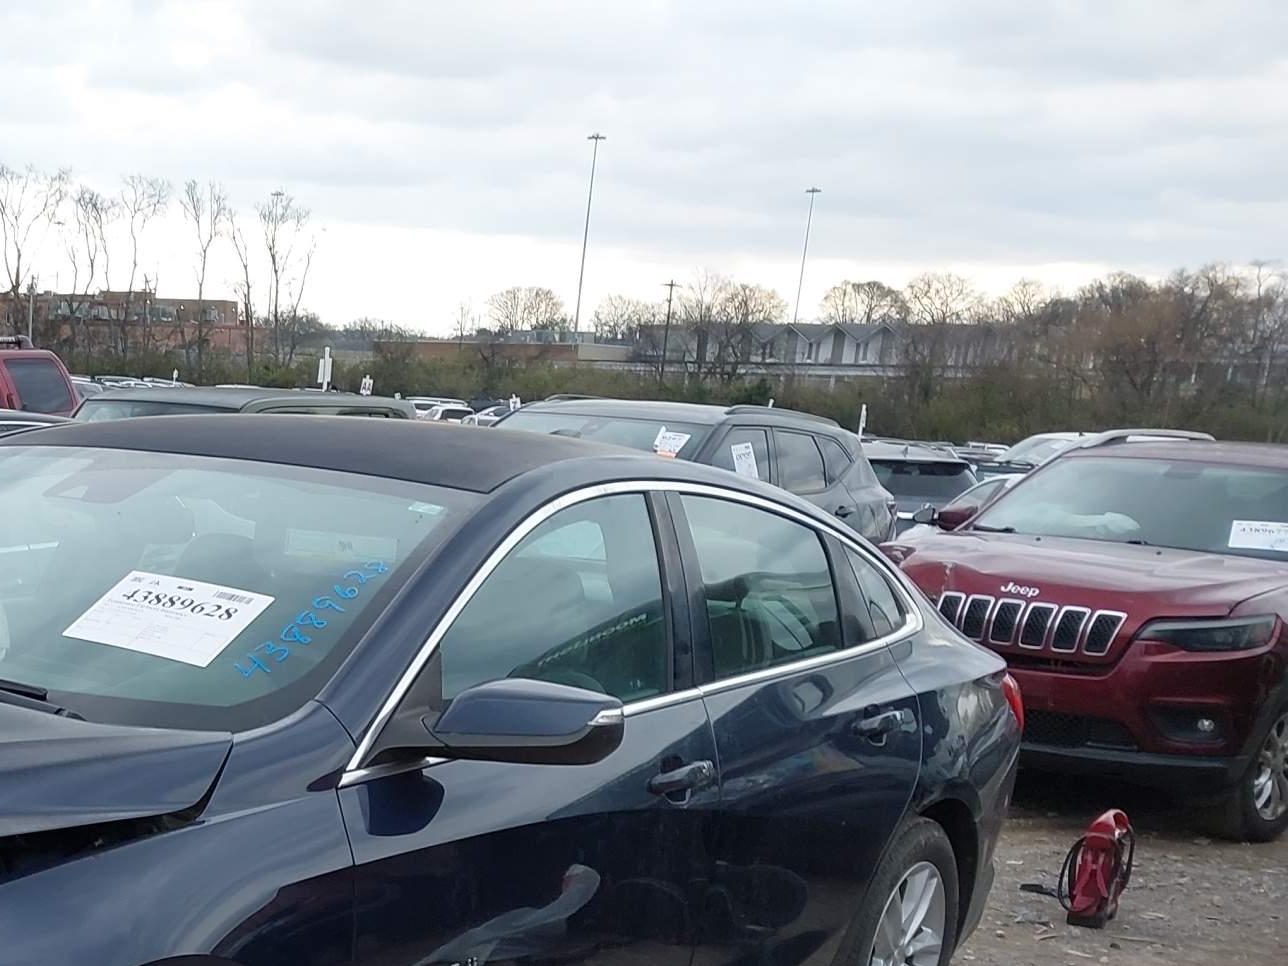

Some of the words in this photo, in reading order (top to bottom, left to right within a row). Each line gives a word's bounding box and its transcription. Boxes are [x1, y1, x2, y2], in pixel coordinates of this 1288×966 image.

[122, 589, 238, 620] 43889628
[1000, 581, 1040, 598] Jeep
[233, 559, 389, 680] 43889628
